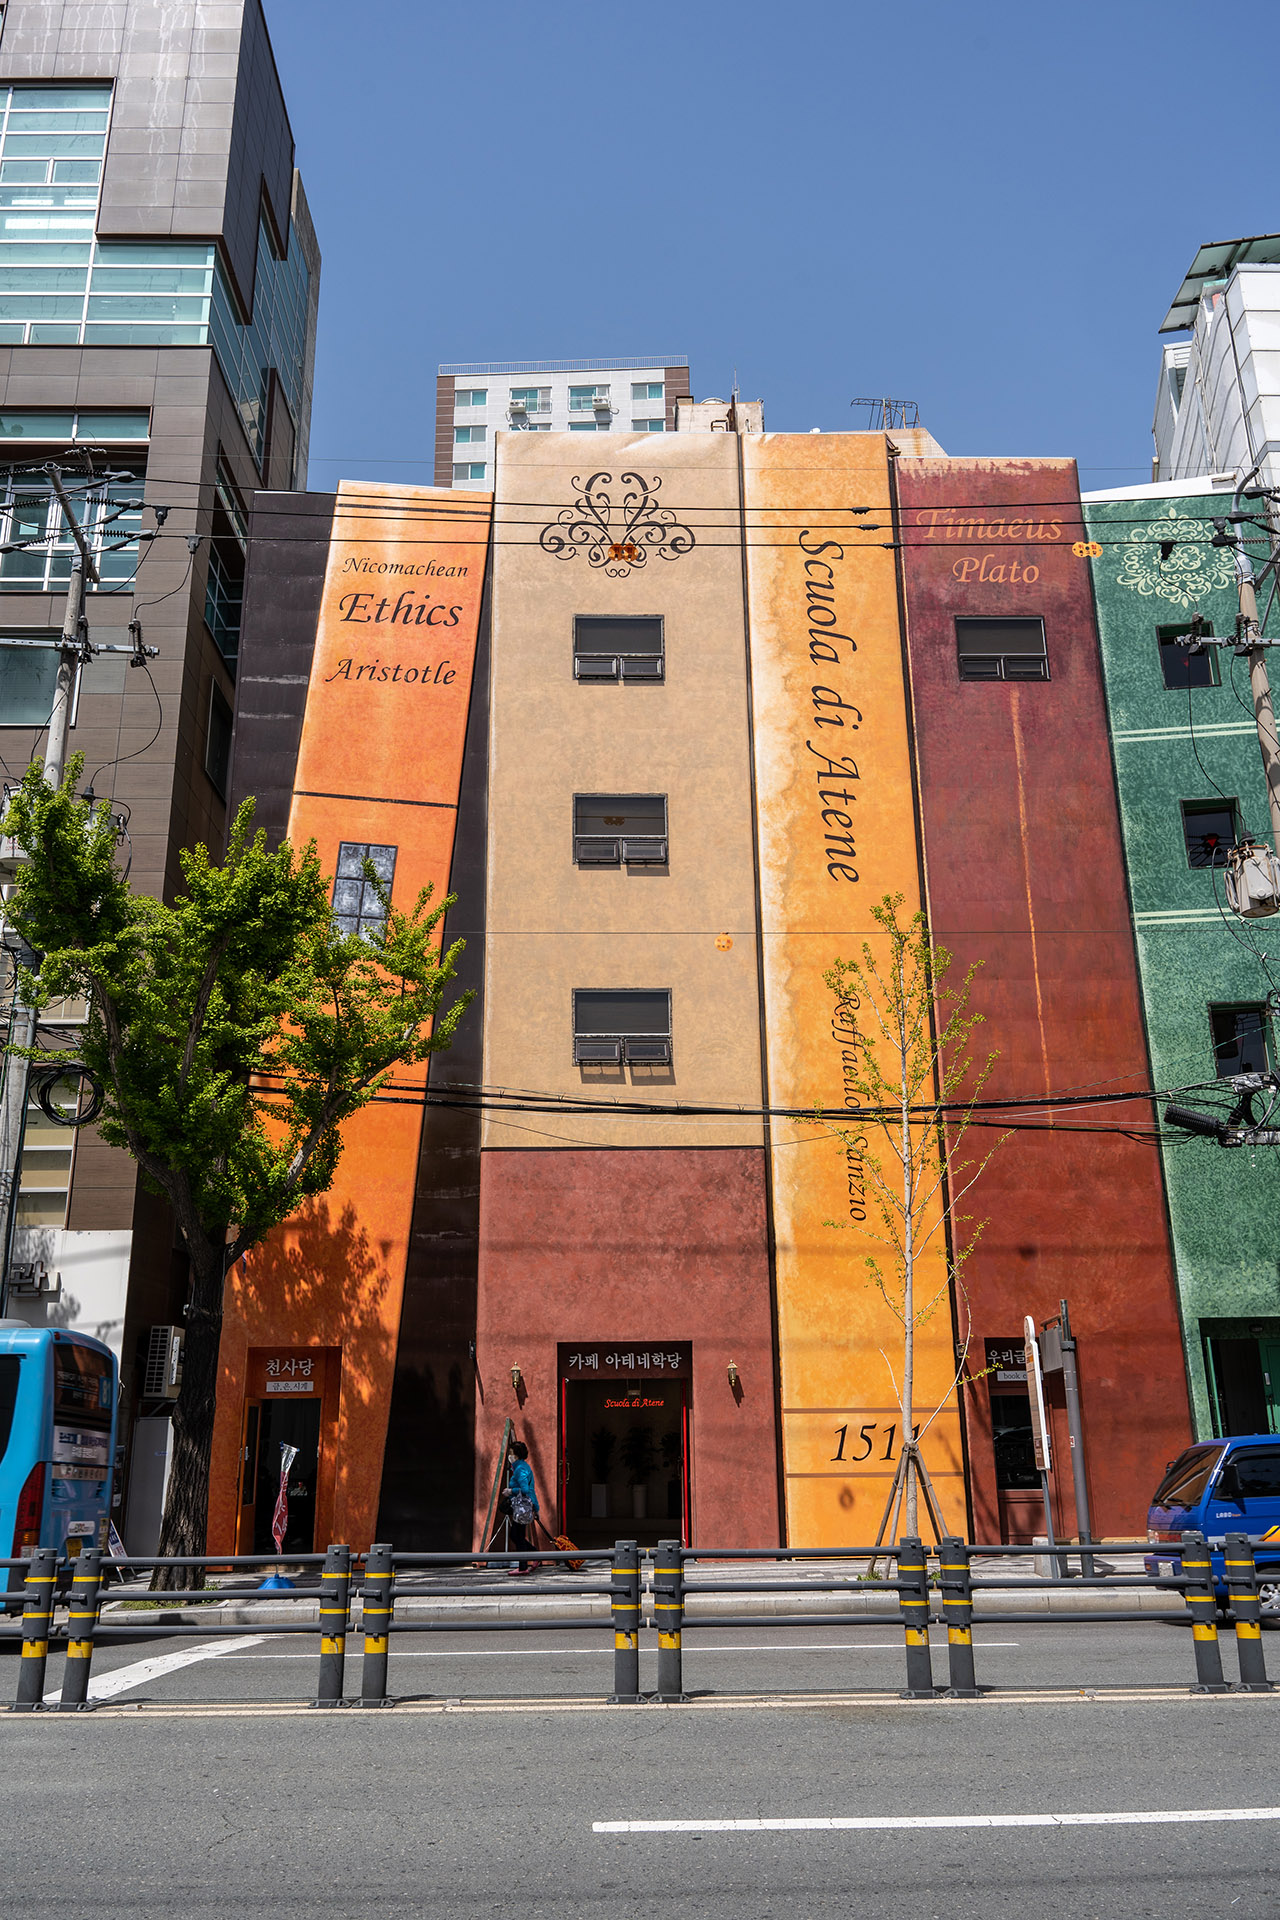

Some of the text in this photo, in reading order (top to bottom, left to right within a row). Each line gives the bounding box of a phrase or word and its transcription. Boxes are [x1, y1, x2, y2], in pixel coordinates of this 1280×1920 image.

[916, 509, 1064, 540] Timaeus
[342, 557, 469, 578] Nicomachean
[952, 554, 1040, 583] Plato
[339, 590, 463, 627] Ethics
[325, 658, 456, 685] Aristotle
[799, 530, 863, 882] Scuola di Atene
[266, 1358, 315, 1377] 천사당
[569, 1352, 682, 1370] 카페 아테네학당
[987, 1349, 1041, 1365] 우리글
[604, 1397, 665, 1408] Scuola di Atene
